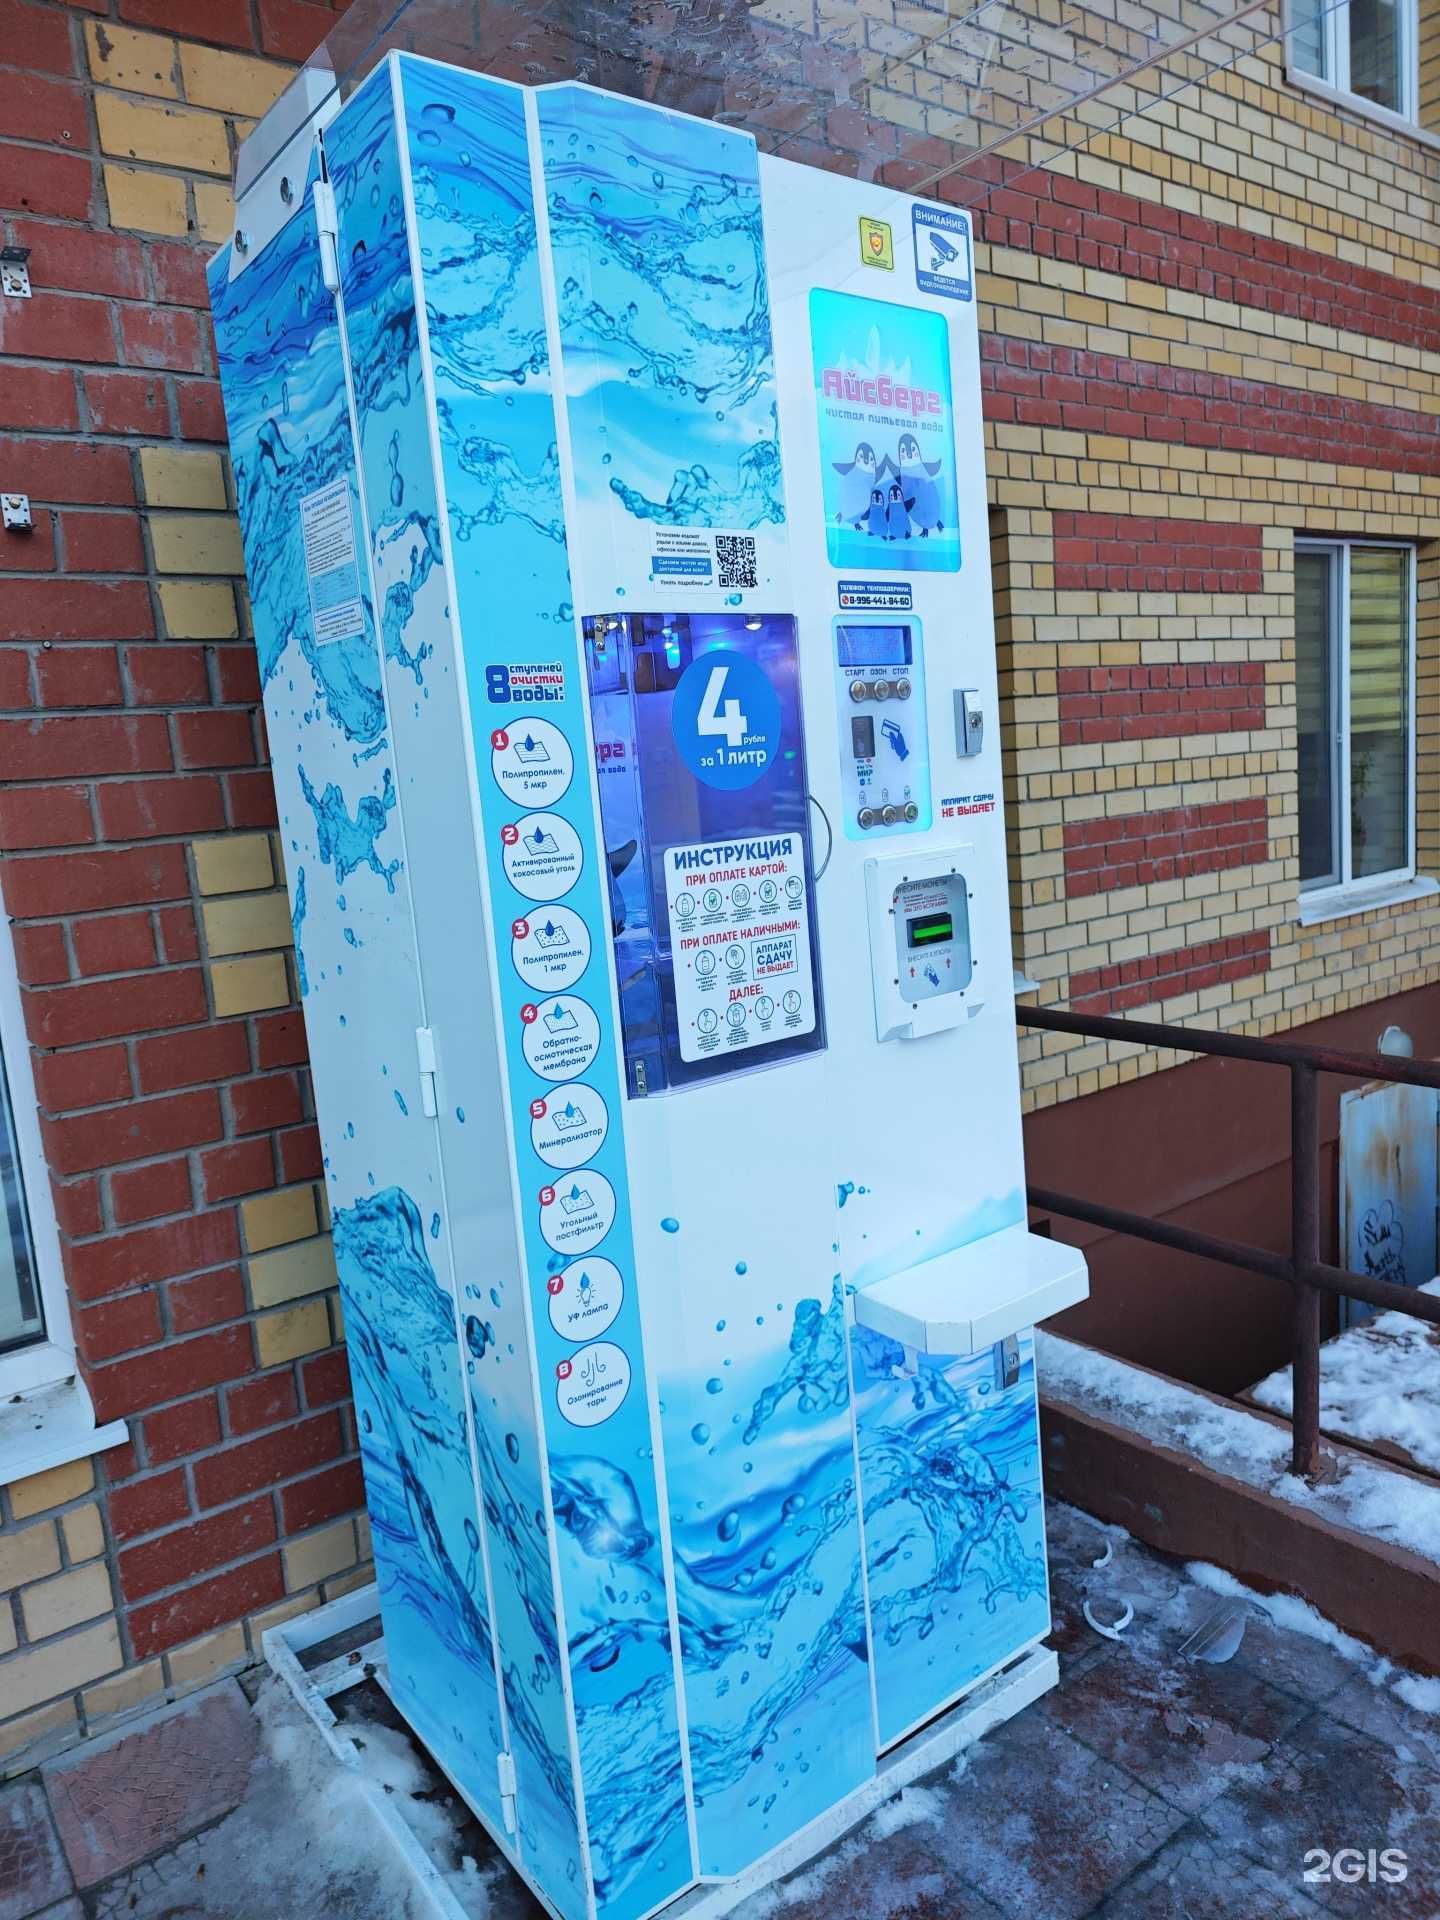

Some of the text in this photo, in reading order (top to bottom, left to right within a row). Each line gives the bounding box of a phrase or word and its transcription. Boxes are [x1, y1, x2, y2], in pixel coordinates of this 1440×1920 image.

[915, 210, 967, 230] ВНИМАНИЕ!
[823, 369, 942, 418] Айсберг
[825, 407, 944, 433] чистая питьевая вода
[509, 663, 562, 674] ступеней
[845, 667, 909, 677] СТАРТ ОЗОН СТОП
[486, 664, 511, 703] 8
[511, 675, 563, 684] очистки
[512, 686, 565, 701] воды:
[697, 666, 748, 747] 4
[495, 733, 504, 746] 1
[743, 735, 766, 745] рубля
[700, 748, 767, 767] за 1 литр
[531, 781, 548, 790] мкр
[941, 793, 994, 806] АППАРАТ СДАЧУ
[942, 802, 996, 818] НЕ ВЫДАЕТ
[504, 827, 515, 841] 2
[512, 852, 575, 868] Активированный
[674, 838, 792, 870] ИНСТРУКЦИЯ
[513, 865, 576, 878] кокосовый уголь
[686, 860, 788, 887] ПРИ ОПЛАТЕ КАРТОЙ:
[514, 921, 525, 936] 3
[680, 920, 801, 950] ПРИ ОПЛАТЕ НАЛИЧНЫМИ:
[756, 940, 793, 954] АППАРАТ
[757, 950, 793, 966] СДАЧУ
[550, 963, 567, 973] мкр
[757, 961, 794, 975] НЕ ВЫДАЕТ
[729, 984, 764, 1002] ДАЛЕЕ:
[523, 1006, 534, 1019] 4
[542, 1035, 583, 1049] Обратно-
[534, 1043, 593, 1062] осмотическая
[543, 1056, 586, 1072] мембрана
[532, 1102, 544, 1116] 5
[539, 1128, 603, 1150] Минерализатор
[541, 1188, 552, 1202] 6
[559, 1211, 599, 1230] Угольный
[556, 1221, 604, 1242] постфильтр
[551, 1278, 560, 1292] 7
[568, 1303, 609, 1323] УФ лампа
[559, 1363, 569, 1377] 8
[567, 1378, 624, 1406] Озонирование
[587, 1395, 607, 1409] тары
